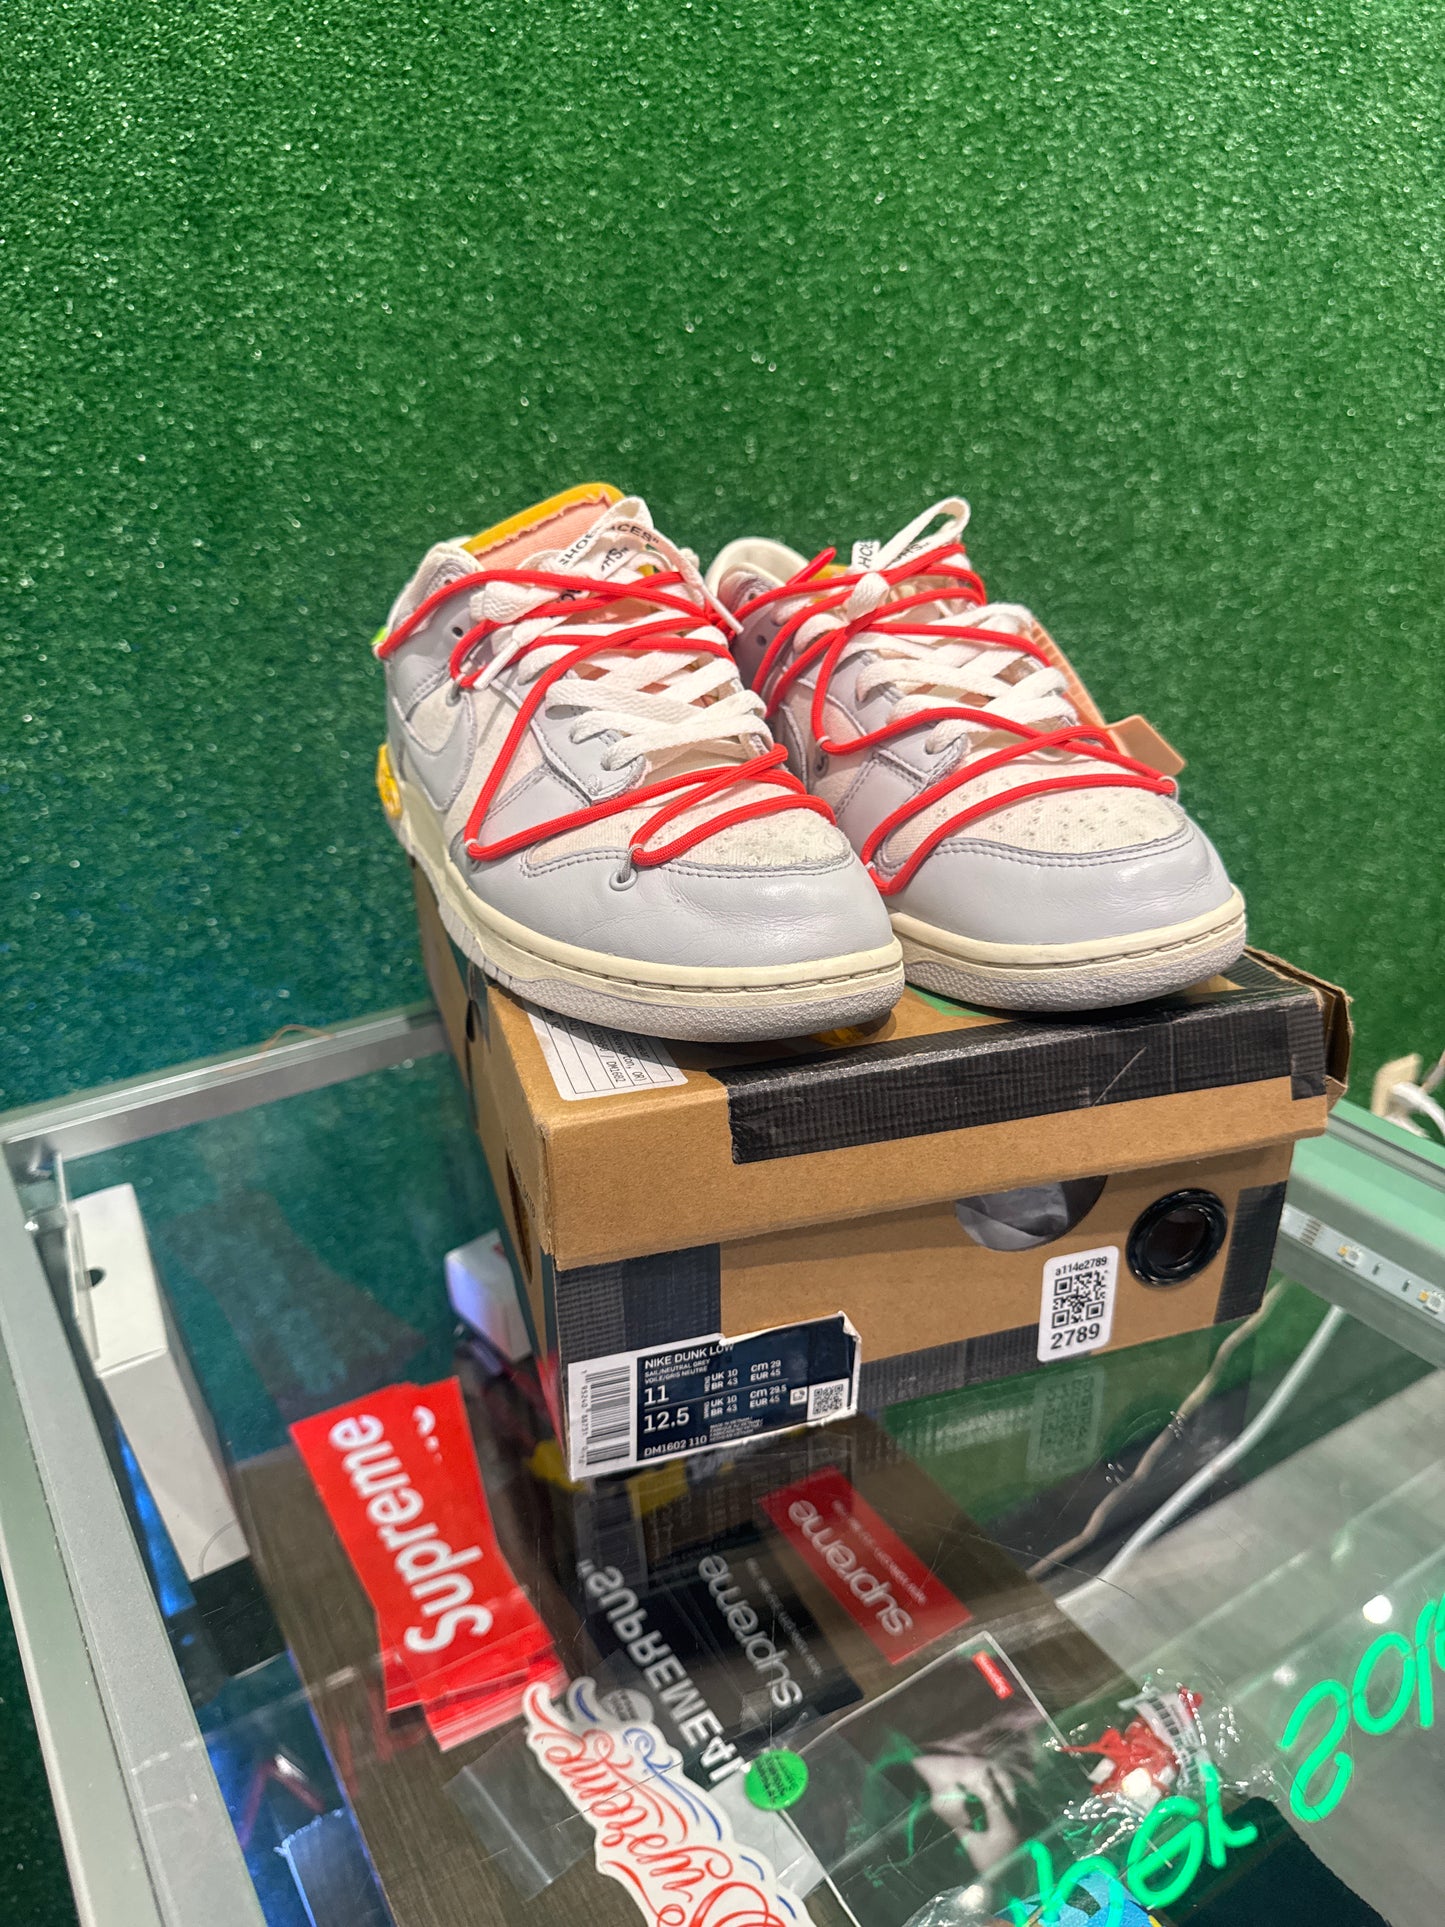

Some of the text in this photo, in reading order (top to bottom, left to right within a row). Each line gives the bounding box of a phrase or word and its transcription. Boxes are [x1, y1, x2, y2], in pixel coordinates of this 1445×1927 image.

[1050, 1322, 1101, 1351] 2789
[644, 1342, 735, 1370] NIKE DUNK LOW
[692, 1358, 711, 1367] GREY
[681, 1365, 708, 1377] NEUTRE
[750, 1359, 782, 1373] cm 29
[711, 1368, 739, 1381] UK 10
[750, 1368, 781, 1382] EUR 45
[711, 1377, 739, 1391] BR 43
[643, 1384, 670, 1407] 11
[749, 1384, 788, 1400] cm 29.5
[710, 1394, 738, 1408] UK 10
[749, 1394, 780, 1409] EUR 45
[710, 1404, 738, 1417] BR 43
[643, 1406, 690, 1434] 12.5
[643, 1434, 708, 1458] DM1602 110
[327, 1412, 493, 1654] Supreme
